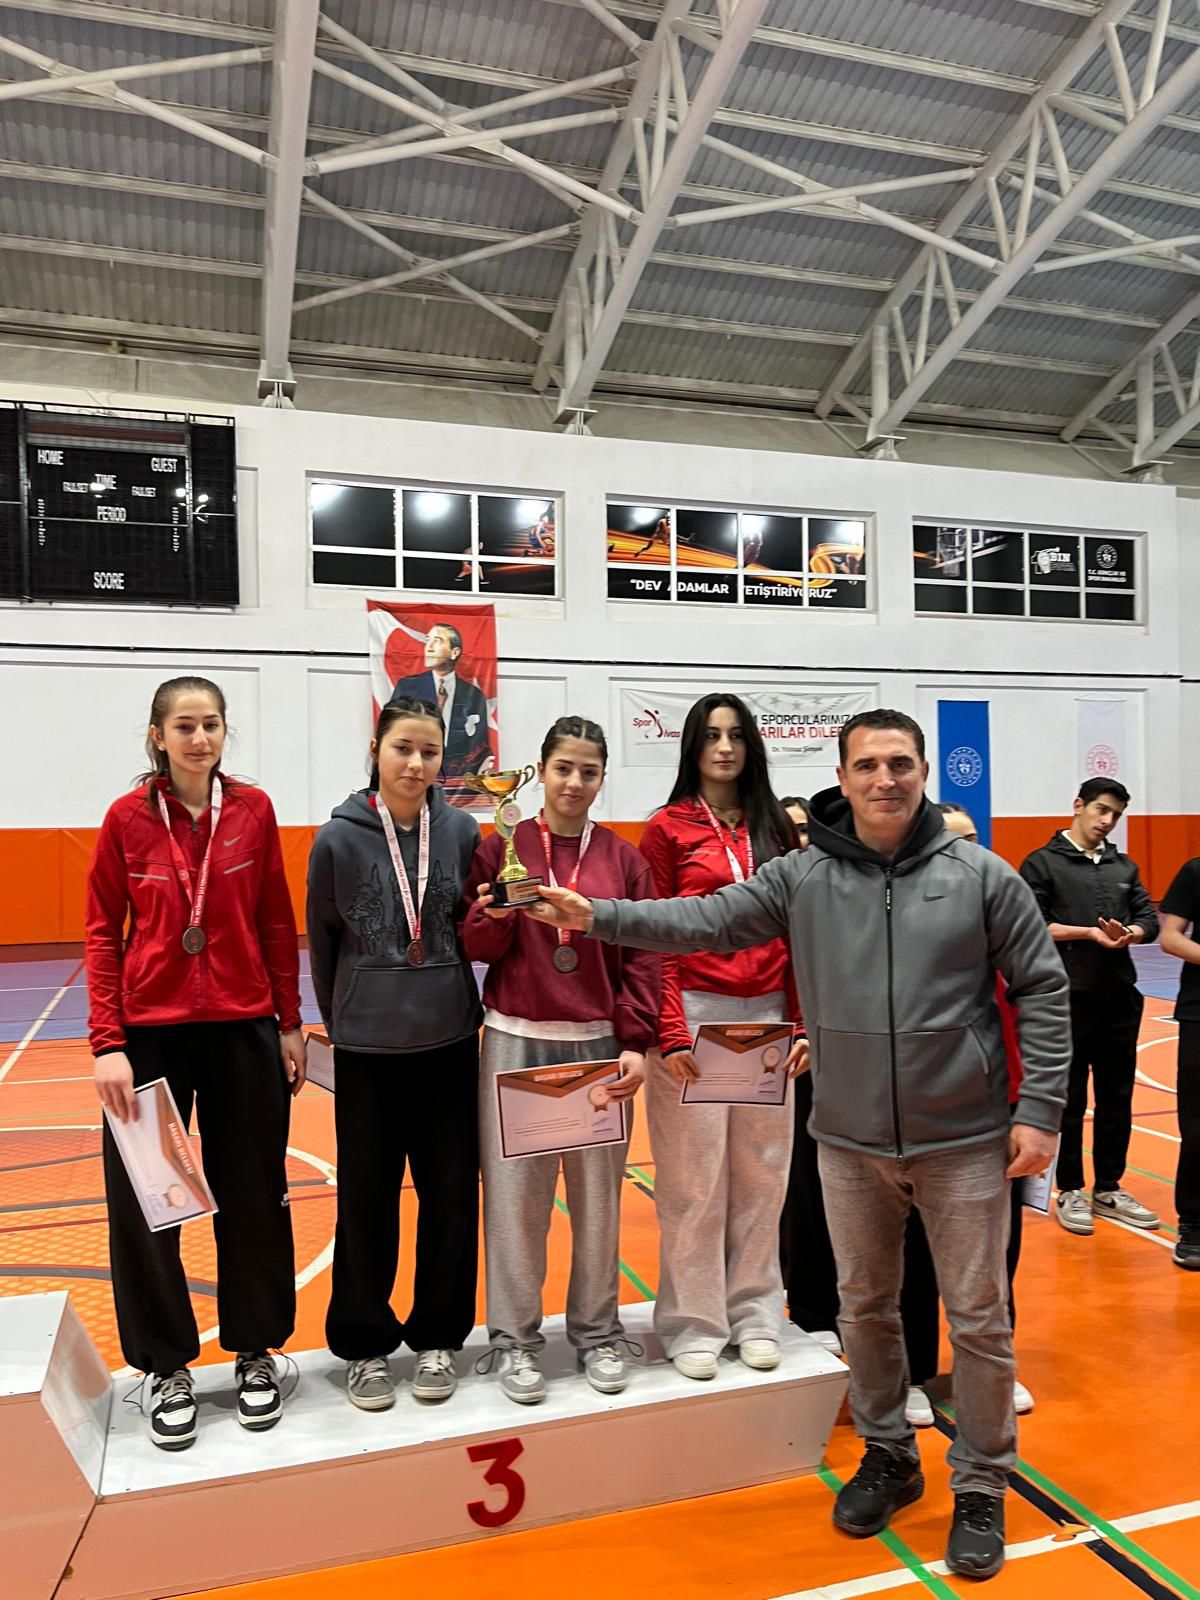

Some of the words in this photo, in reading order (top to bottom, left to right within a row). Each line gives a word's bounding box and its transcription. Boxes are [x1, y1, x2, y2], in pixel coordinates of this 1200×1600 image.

[37, 449, 64, 465] HOME
[151, 457, 178, 472] GUEST
[96, 505, 127, 522] PERIOD
[93, 571, 125, 590] SCORE
[632, 717, 652, 728] Spor
[761, 714, 855, 725] SPORCULARIMIZ
[466, 1437, 526, 1529] 3
